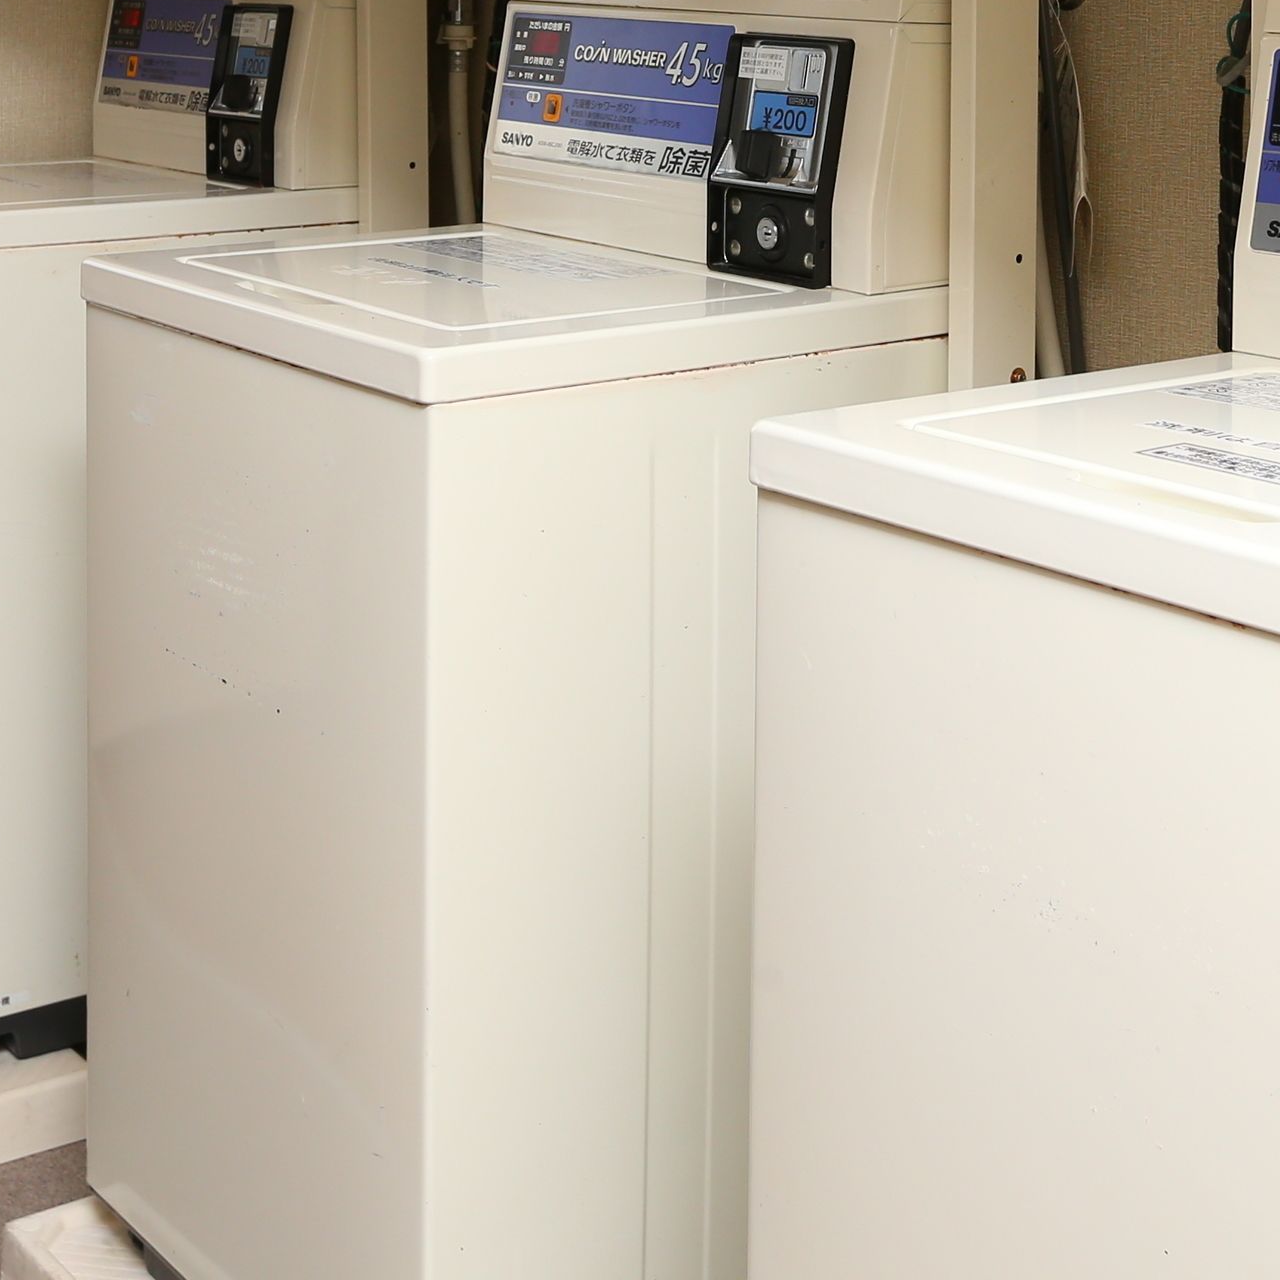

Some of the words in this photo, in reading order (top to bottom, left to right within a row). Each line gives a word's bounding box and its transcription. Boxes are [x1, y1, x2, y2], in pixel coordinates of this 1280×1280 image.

[613, 48, 667, 68] WASHER
[762, 107, 807, 132] ¥200
[501, 132, 534, 147] SANYO
[567, 138, 657, 166] 電解水で衣類を
[657, 146, 712, 178] 除菌
